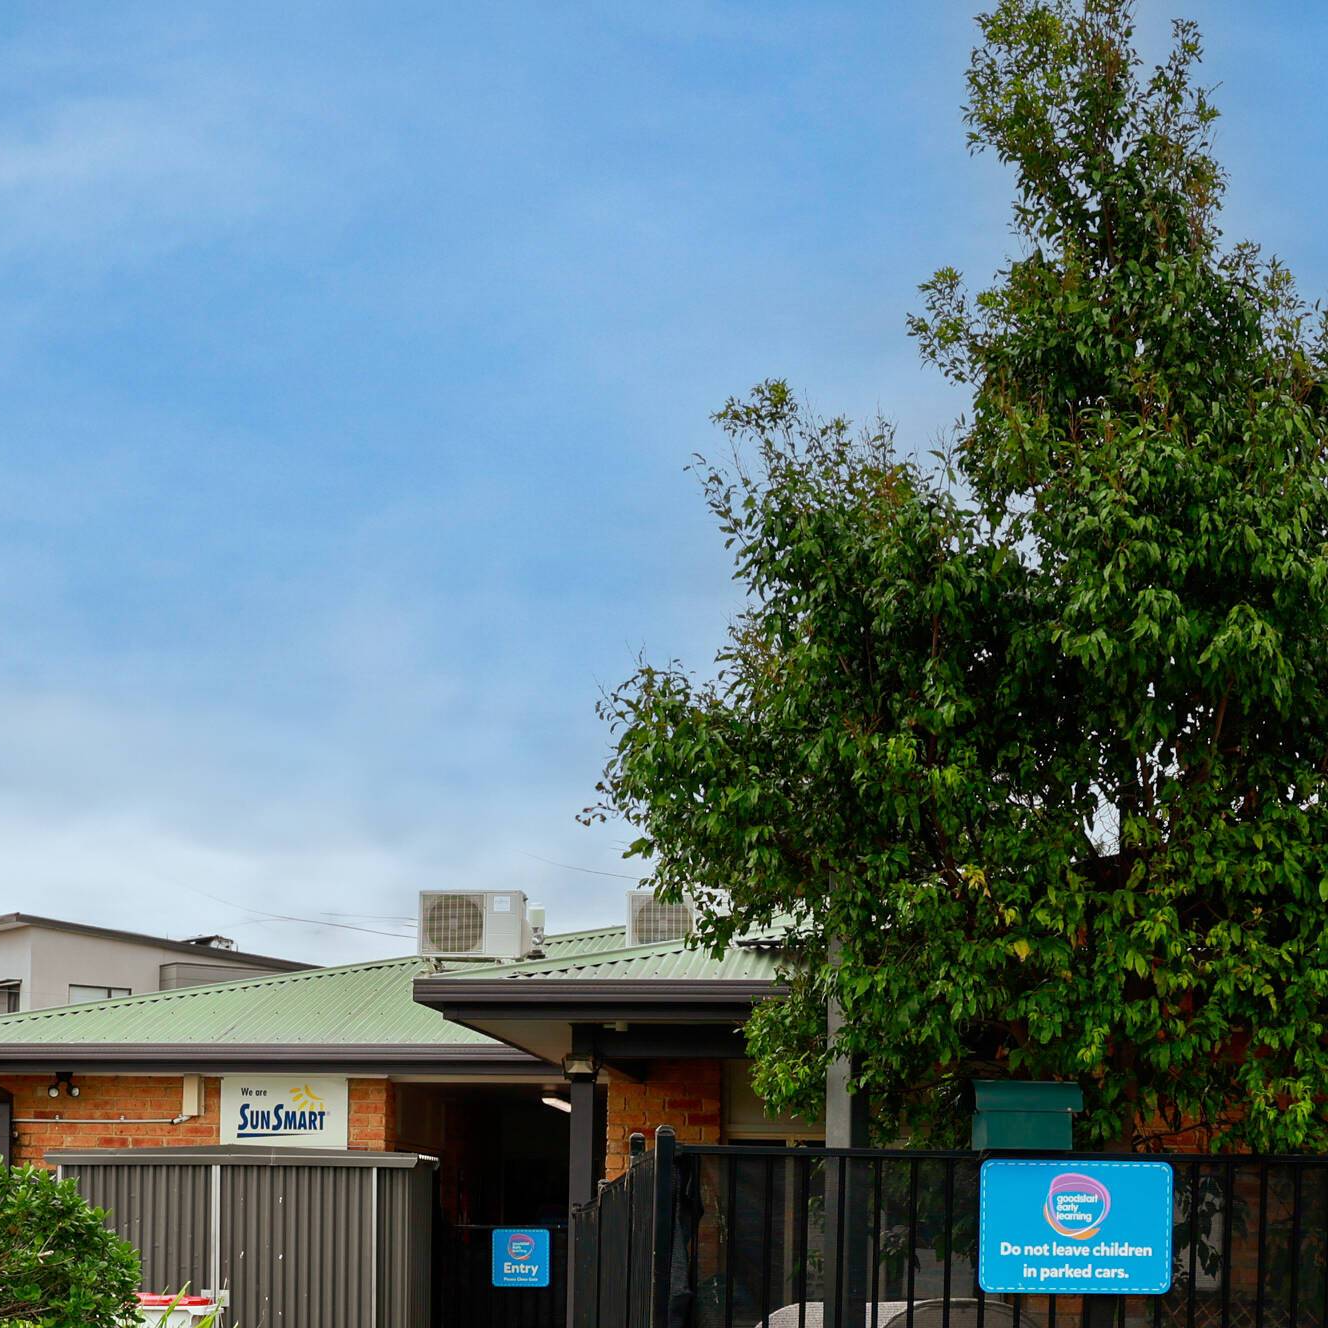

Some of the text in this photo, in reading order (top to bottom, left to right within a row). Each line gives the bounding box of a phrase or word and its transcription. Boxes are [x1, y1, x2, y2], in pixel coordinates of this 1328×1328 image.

[241, 1088, 253, 1096] We
[1056, 1194, 1098, 1205] goodstart
[1056, 1204, 1078, 1213] early
[1056, 1212, 1092, 1222] learning
[1000, 1242, 1152, 1257] Do not leave children
[504, 1262, 539, 1276] Entry
[1023, 1264, 1130, 1282] in parked cars.
